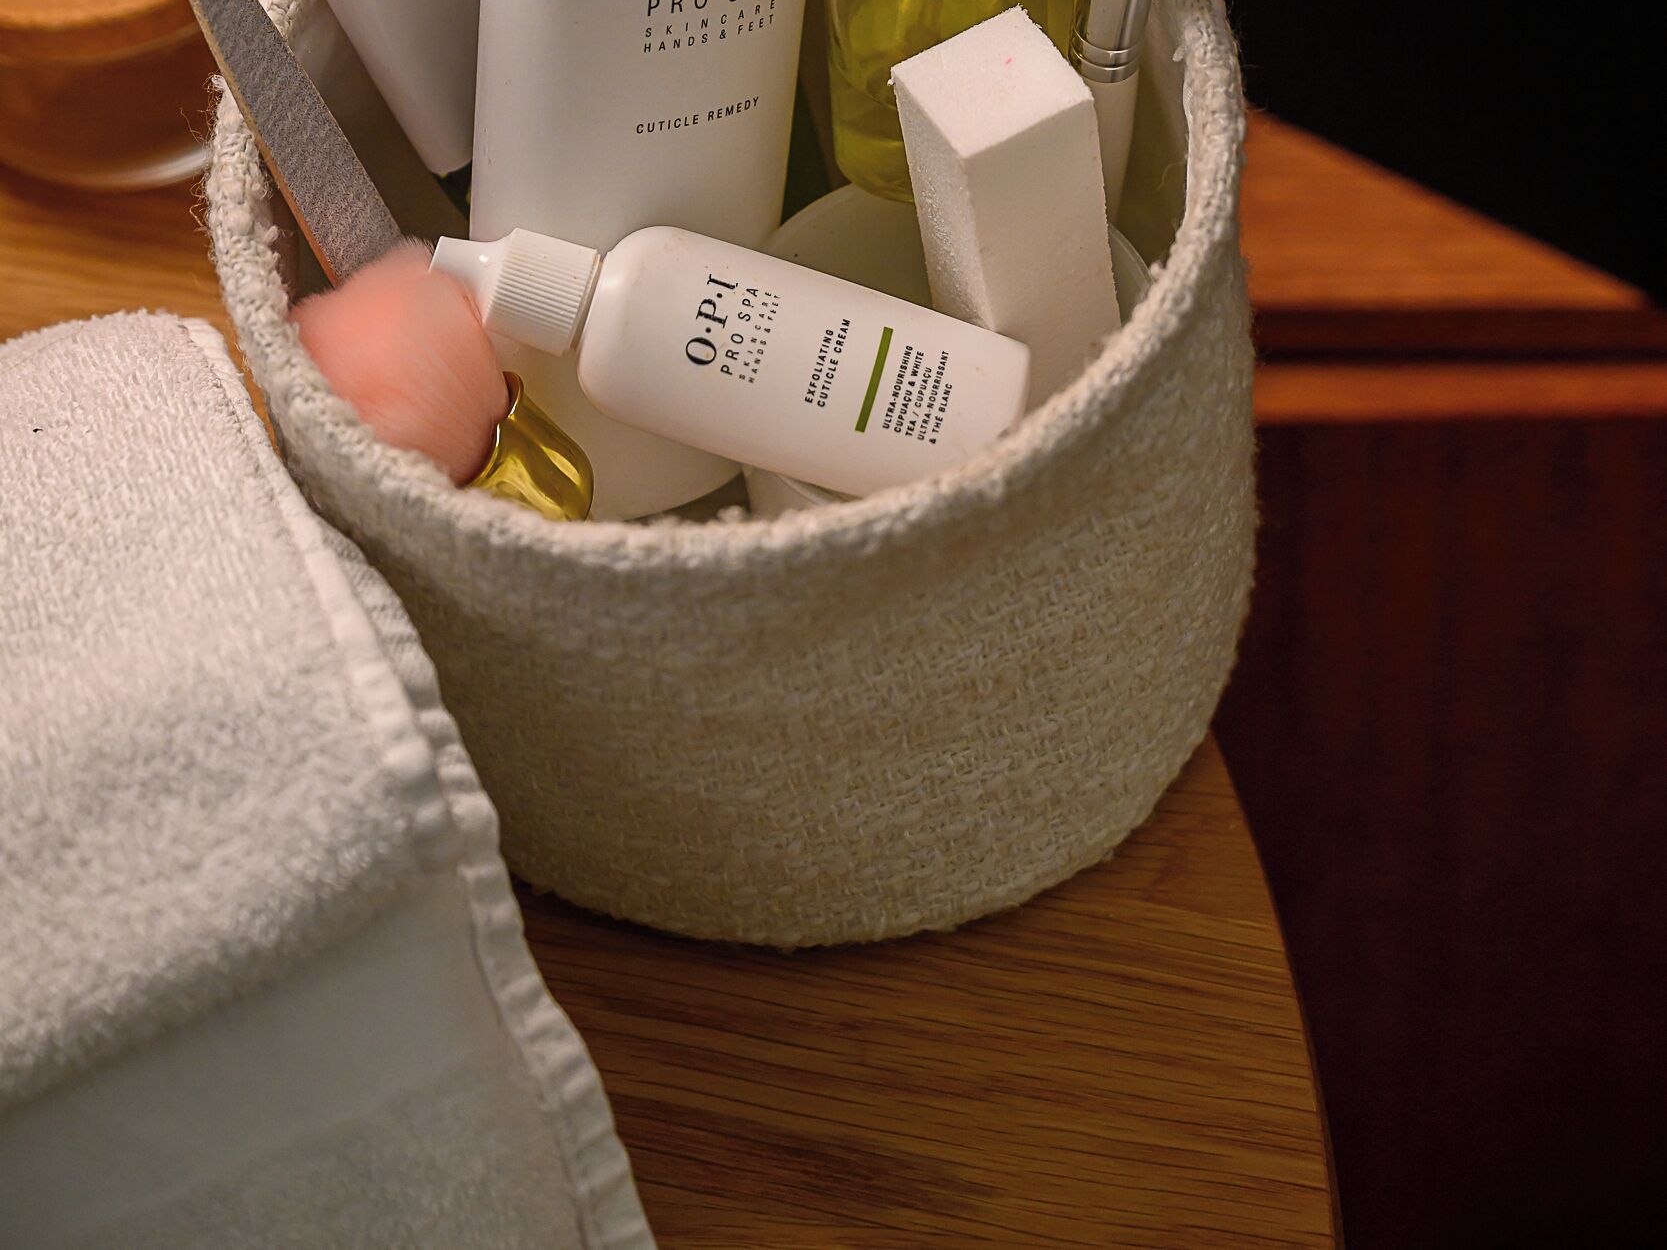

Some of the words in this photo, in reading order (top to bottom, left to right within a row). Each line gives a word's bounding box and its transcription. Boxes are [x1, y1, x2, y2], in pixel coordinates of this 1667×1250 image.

[643, 33, 709, 53] HANDS
[719, 29, 727, 40] &
[737, 14, 774, 36] FEET
[645, 0, 776, 38] SKINCARE
[636, 114, 699, 135] CUTICLE
[707, 96, 759, 122] REMEDY
[720, 333, 744, 376] PRO
[738, 287, 759, 322] SPA
[748, 340, 767, 384] HANDS
[767, 295, 781, 321] FEET
[817, 359, 839, 408] CUTICLE
[834, 318, 851, 354] CREAM
[911, 351, 925, 377] WHITE
[804, 329, 834, 403] EXFOLIATING
[882, 345, 913, 430] ULTRA-NOURISHING
[908, 380, 916, 388] &
[917, 350, 950, 441] ULTRA-NOURRISSANT
[893, 389, 913, 434] CUPUAÇU
[905, 419, 917, 438] TEA
[914, 367, 932, 408] CUPUAÇU
[928, 437, 937, 445] &
[938, 383, 953, 413] BLANC
